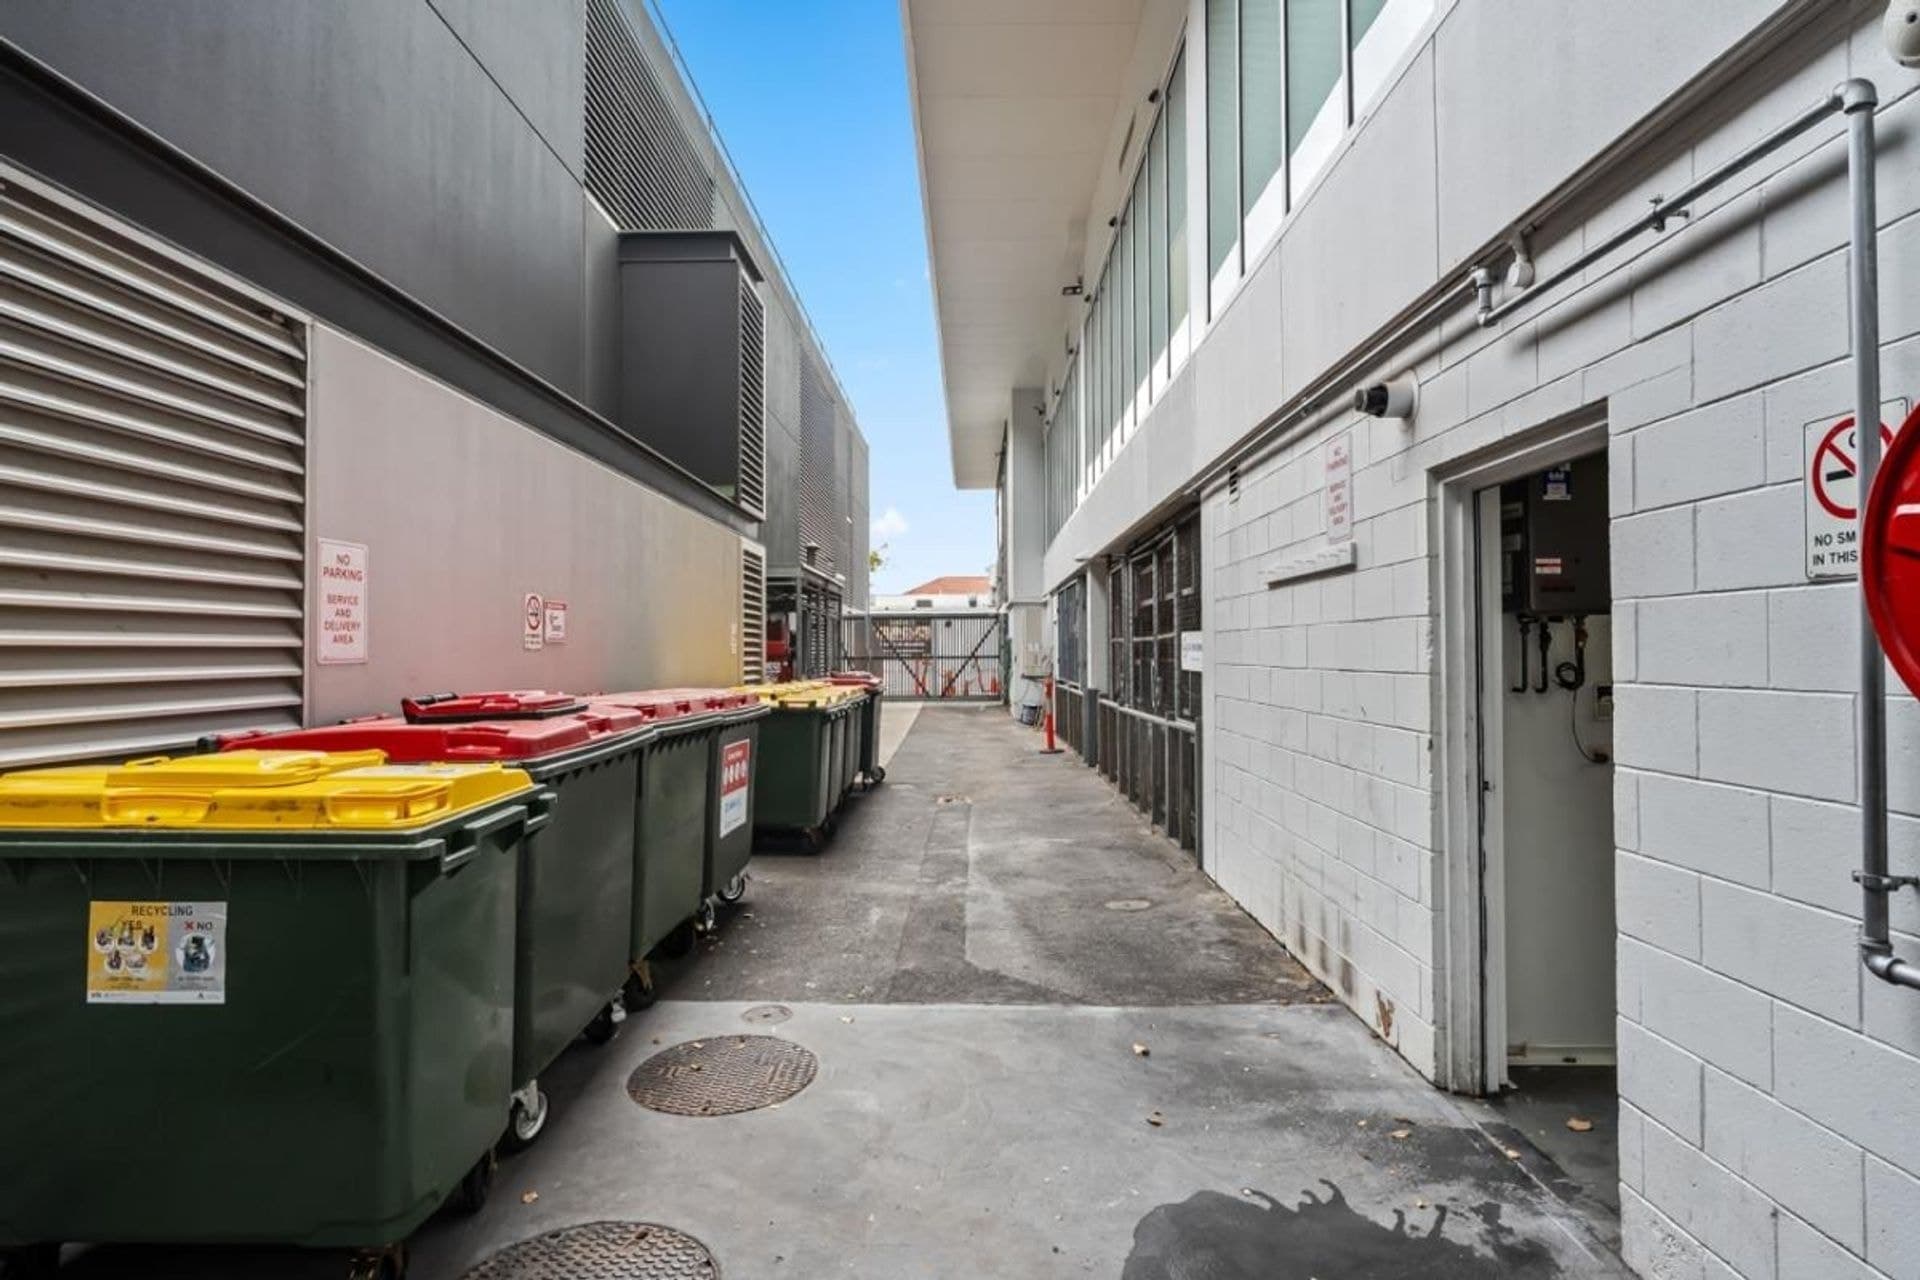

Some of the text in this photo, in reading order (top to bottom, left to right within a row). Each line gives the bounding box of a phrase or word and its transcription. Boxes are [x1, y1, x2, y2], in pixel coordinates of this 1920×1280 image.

[1814, 533, 1833, 547] NO
[336, 554, 350, 566] NO
[1812, 550, 1858, 566] IN THIS
[323, 567, 362, 582] PARKING
[327, 593, 359, 606] SERVICE
[335, 608, 351, 618] AND
[324, 621, 360, 632] DELIVERY
[333, 634, 354, 644] AREA
[131, 905, 193, 916] RECYCLING
[197, 921, 213, 930] NO
